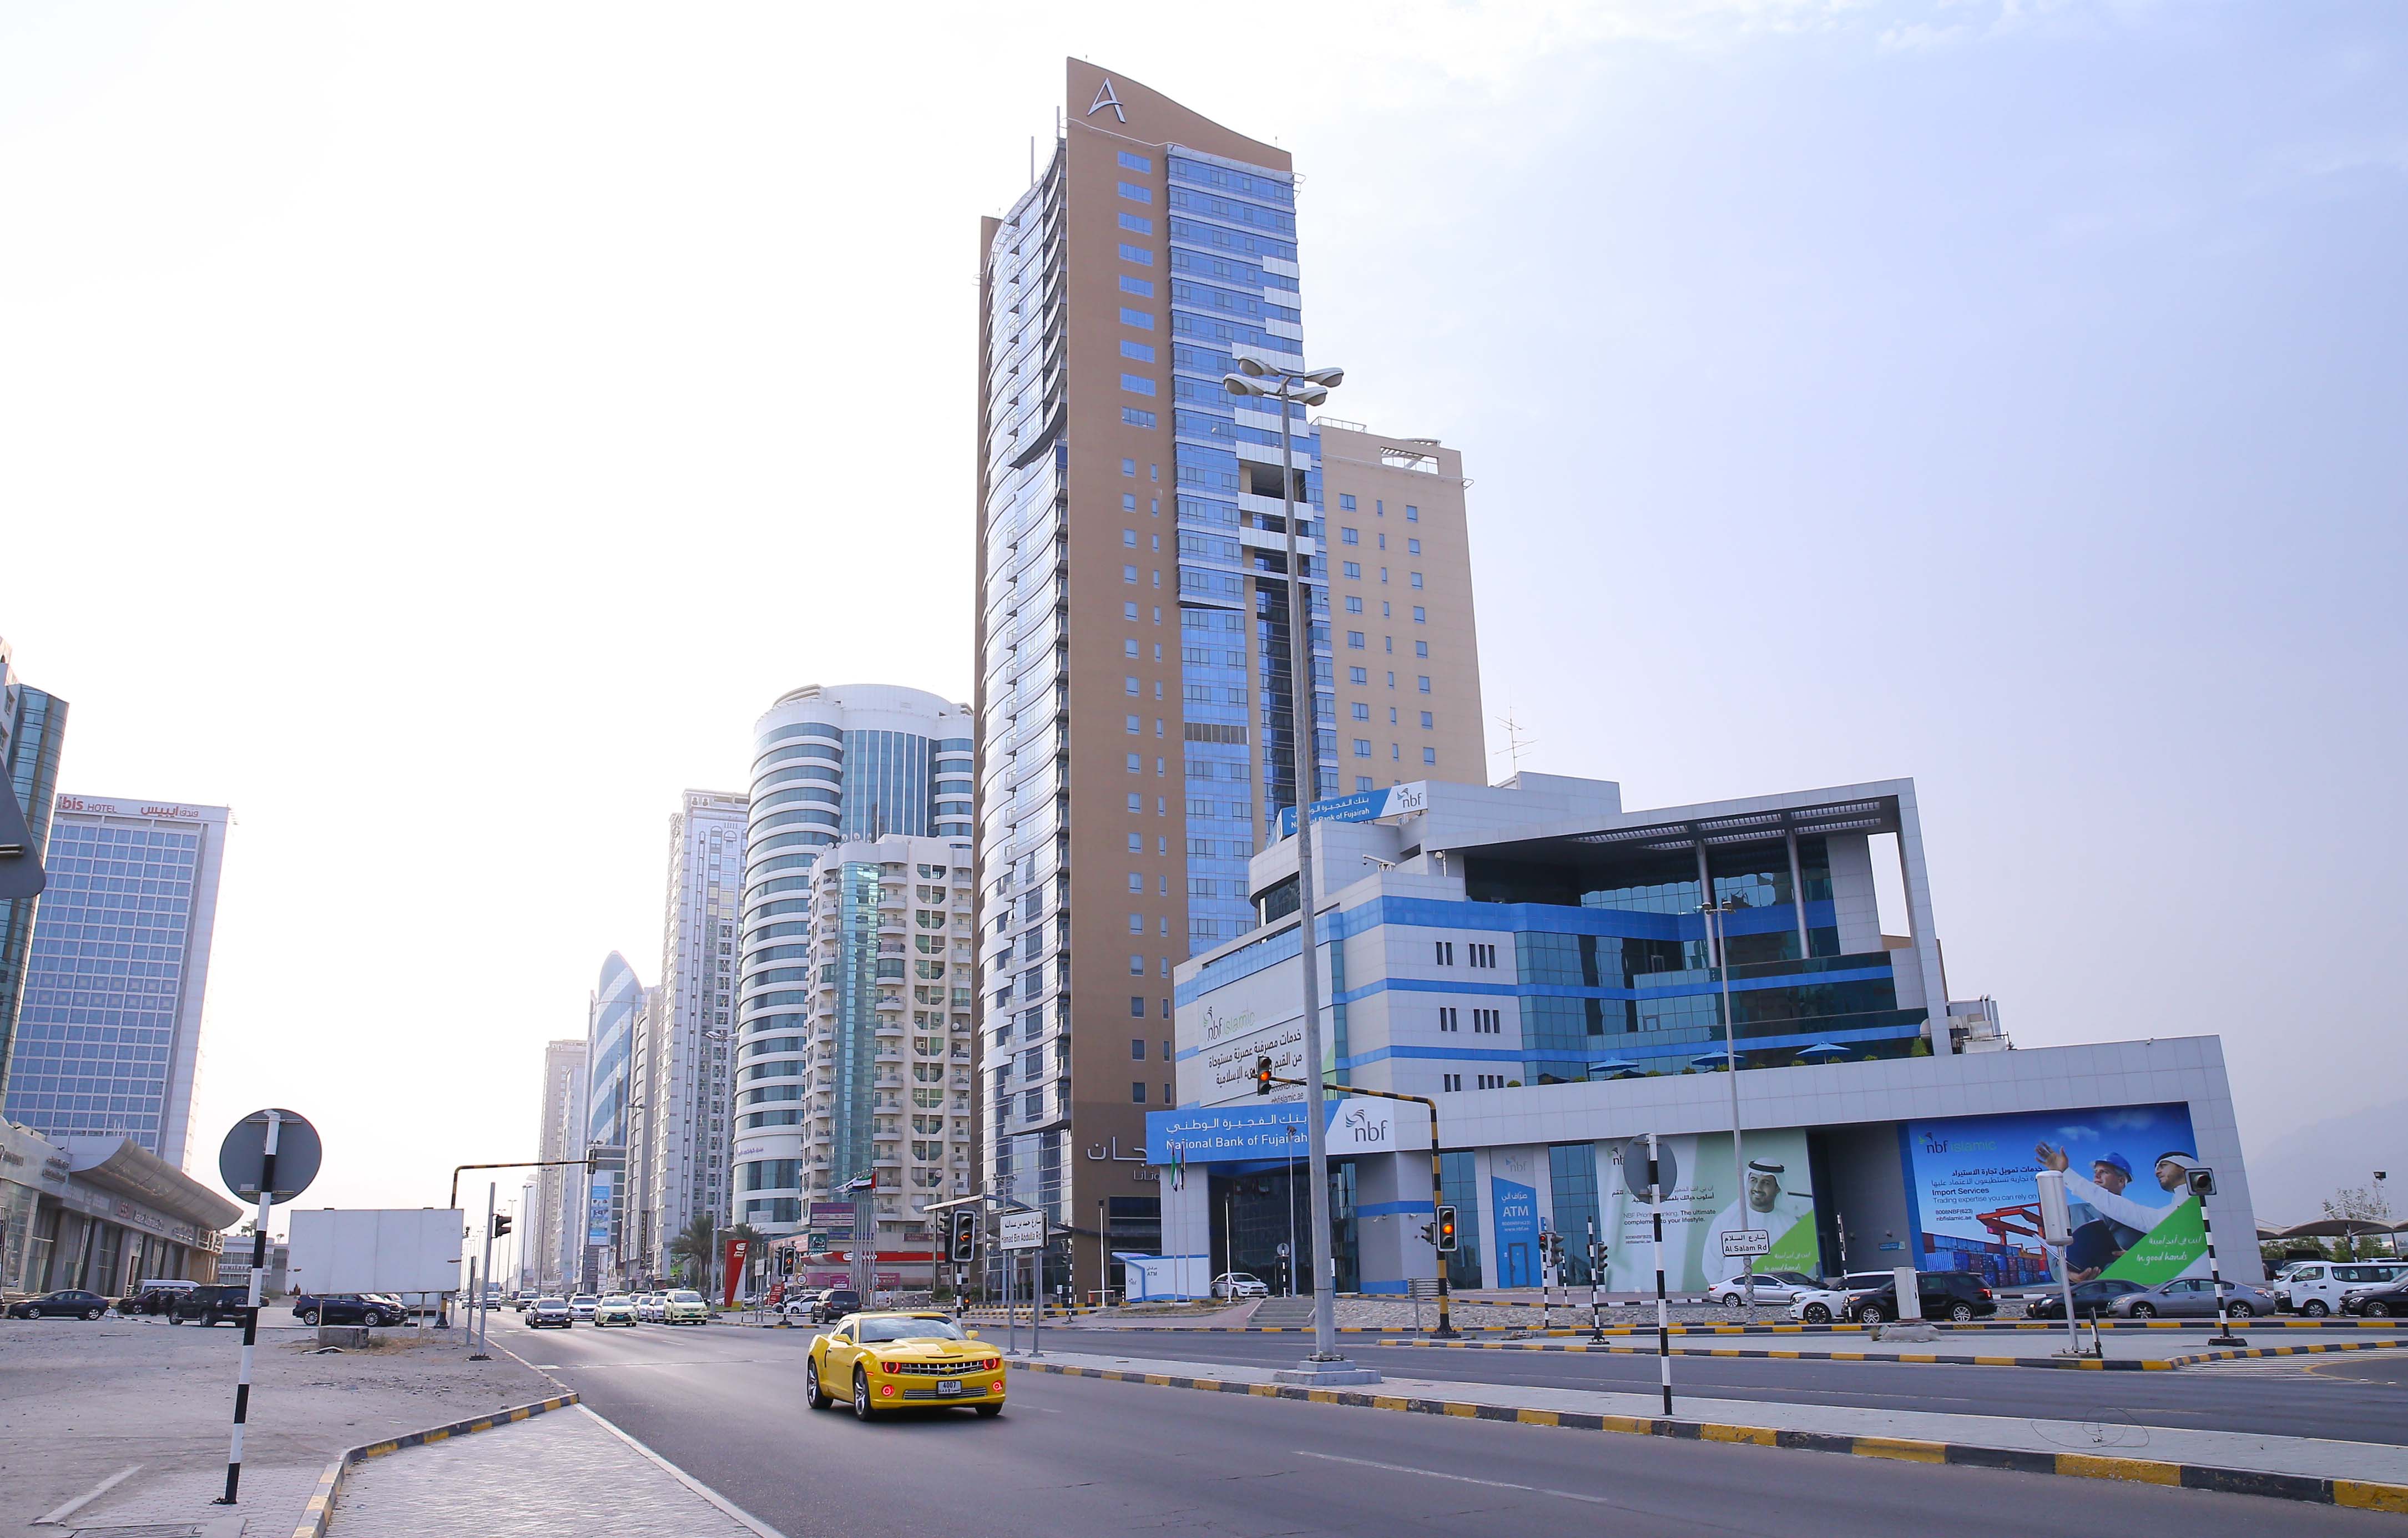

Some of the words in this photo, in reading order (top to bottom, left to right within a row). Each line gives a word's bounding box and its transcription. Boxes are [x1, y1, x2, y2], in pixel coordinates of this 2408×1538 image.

[59, 796, 84, 811] ibis
[87, 803, 118, 814] HOTEL
[1321, 799, 1352, 812] الفجيرة
[1402, 793, 1422, 808] nbf
[179, 808, 199, 818] فندق
[1344, 807, 1370, 819] Fujairah
[1207, 1018, 1223, 1041] nbf
[1223, 1012, 1256, 1035] islamic
[1279, 1029, 1302, 1046] خدمات
[1254, 1039, 1278, 1056] مصرفية
[1234, 1046, 1253, 1063] عصرية
[1292, 1054, 1303, 1067] من
[1209, 1053, 1233, 1070] مستوحاة
[1274, 1051, 1291, 1075] القيم
[1216, 1066, 1243, 1088] الإسلامية
[1165, 1117, 1219, 1134] الوطني
[1222, 1114, 1276, 1131] الفجيرة
[1278, 1113, 1308, 1125] بنك
[1354, 1119, 1388, 1142] nbf
[1215, 1136, 1244, 1147] Bank
[1247, 1135, 1259, 1146] of
[1926, 1140, 1948, 1154] nbf
[1950, 1140, 1998, 1152] islamic
[1510, 1160, 1527, 1172] nbf
[1951, 1168, 1980, 1177] الاستيراد
[1981, 1168, 1997, 1176] تجارة
[1998, 1167, 2019, 1176] تمويل
[1931, 1188, 1956, 1197] Import
[1958, 1195, 1987, 1203] expertise
[1502, 1205, 1529, 1217] ATM
[1031, 1215, 1041, 1228] شارع
[1624, 1218, 1654, 1226] compleme
[1001, 1235, 1013, 1243] Hamad
[1021, 1231, 1035, 1242] Abdulla
[1036, 1230, 1042, 1240] Rd
[1724, 1235, 1745, 1244] السلام
[1748, 1233, 1766, 1243] شارع
[2144, 1251, 2164, 1266] good
[2164, 1250, 2187, 1261] hands
